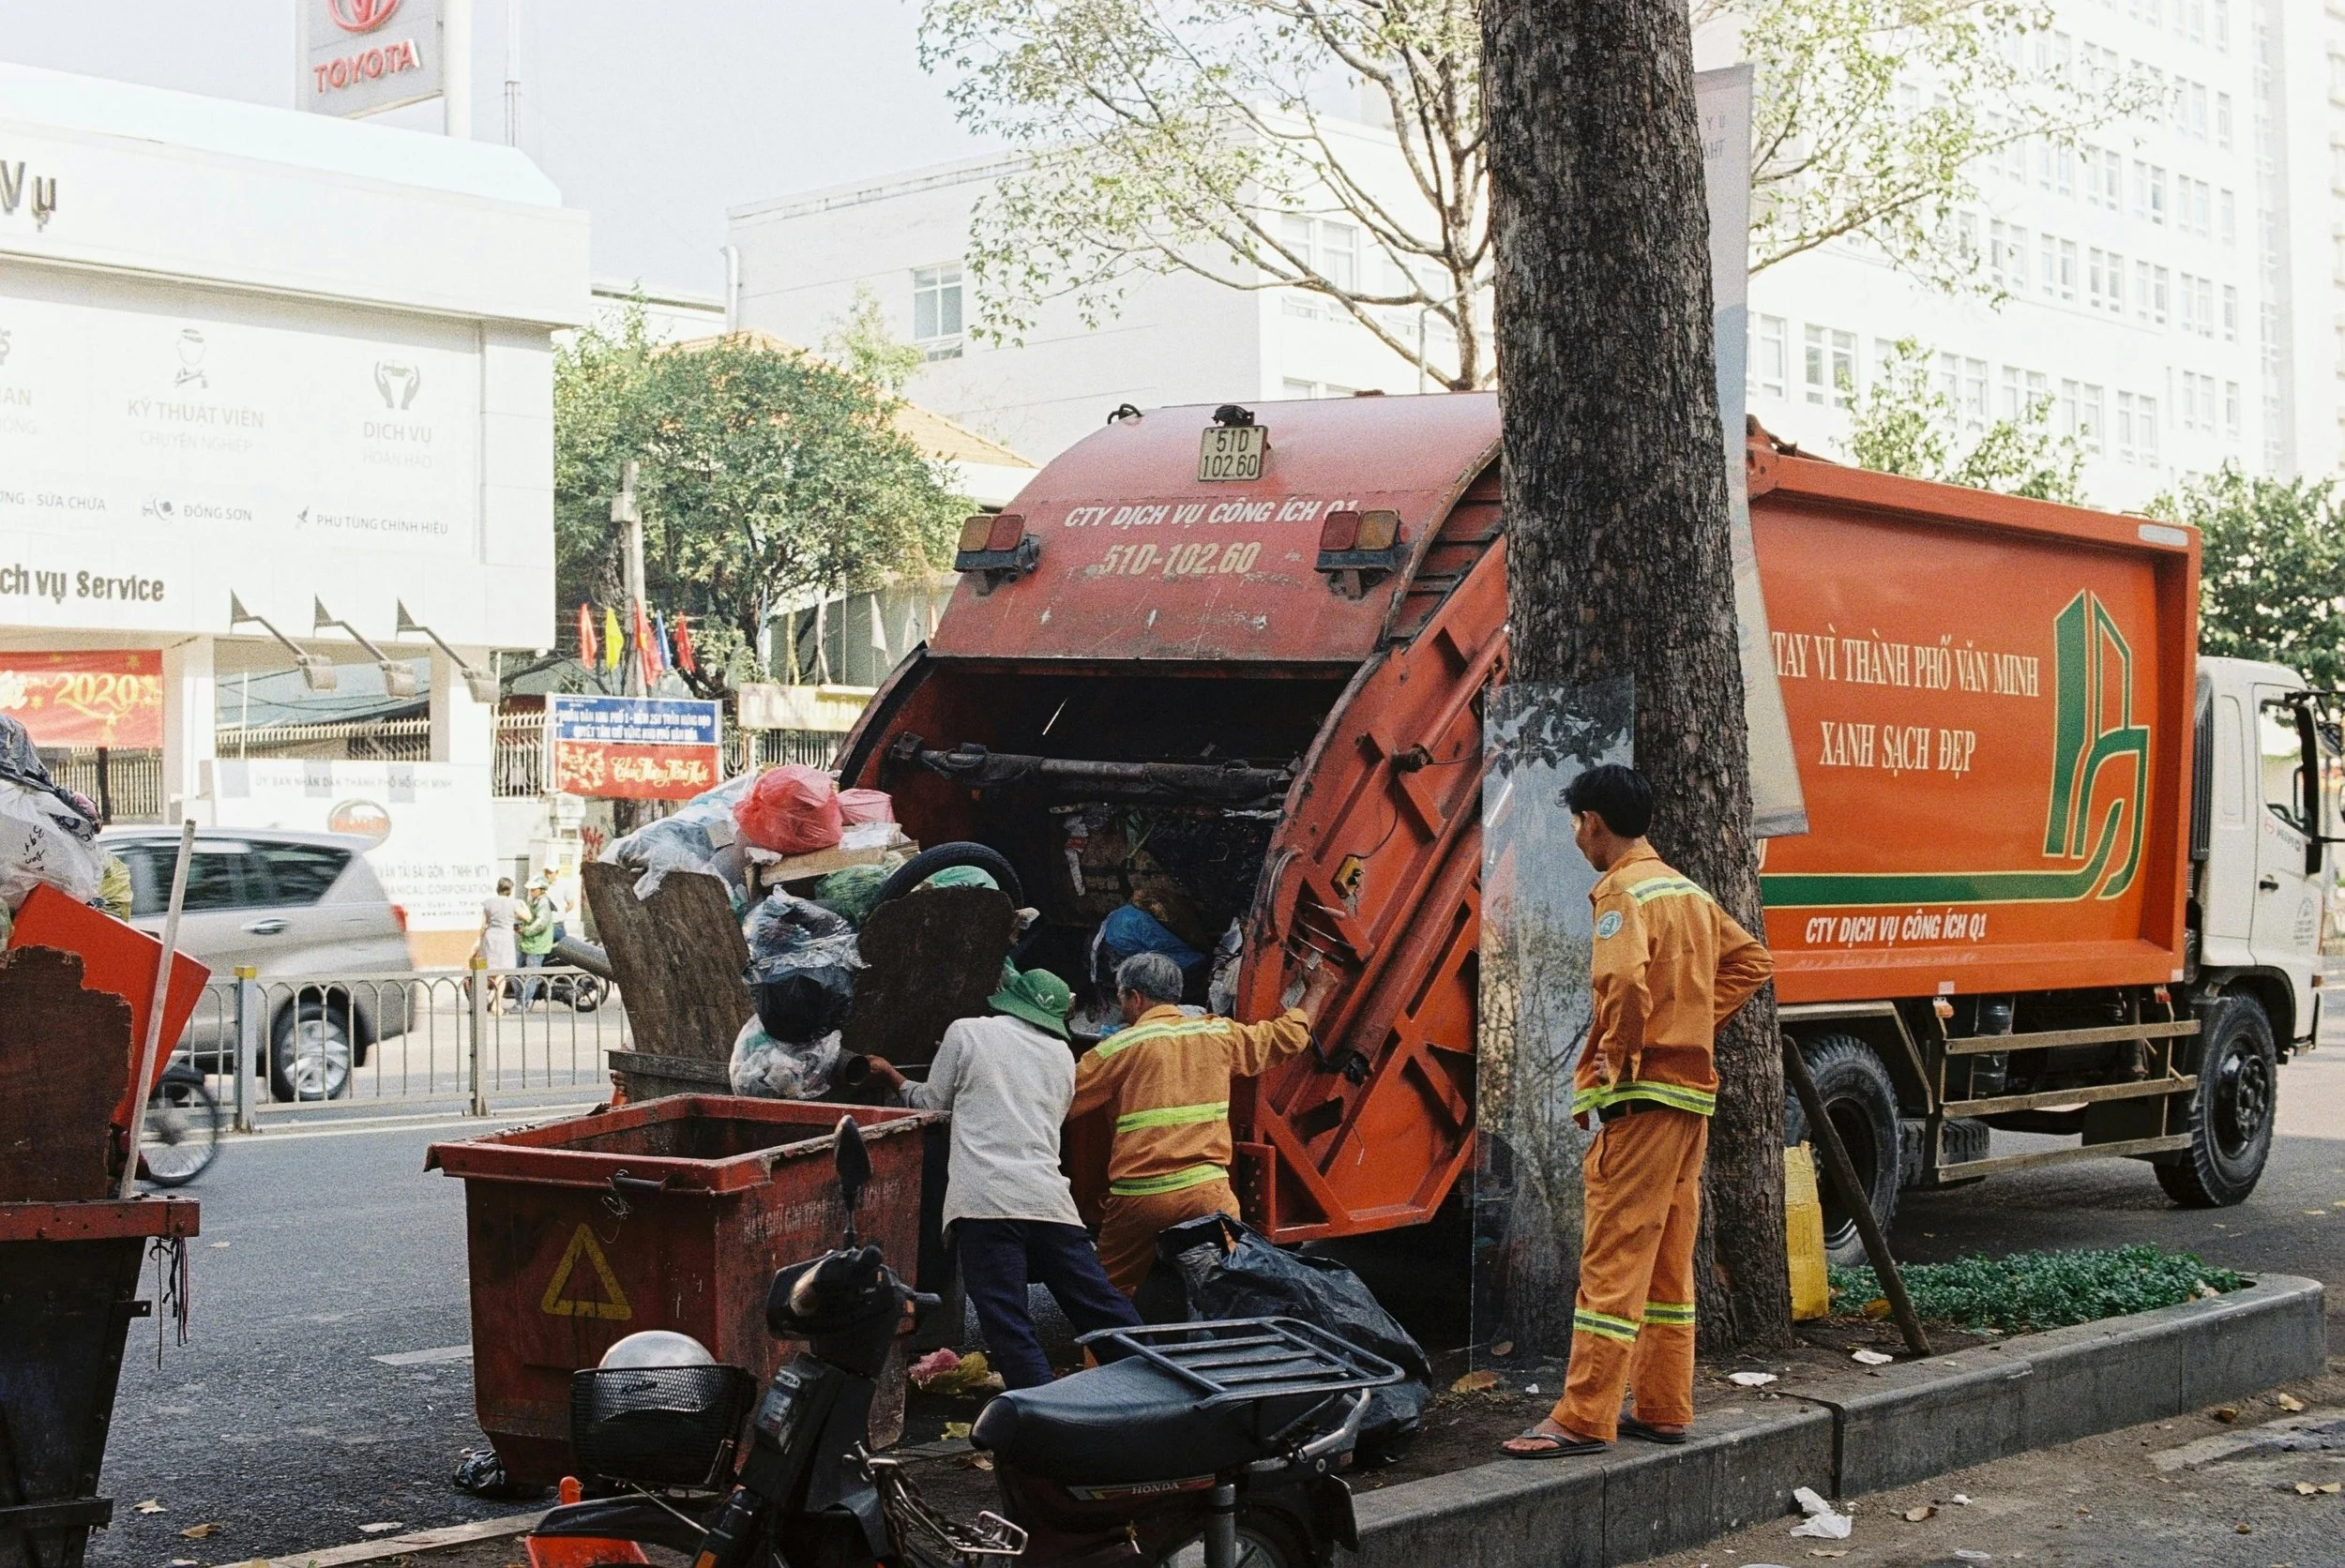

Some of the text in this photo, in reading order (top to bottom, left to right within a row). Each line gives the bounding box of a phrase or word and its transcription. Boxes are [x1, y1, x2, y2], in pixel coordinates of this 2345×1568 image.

[314, 39, 419, 93] TOYOTA
[0, 159, 56, 233] Vụ
[0, 387, 31, 406] AN
[363, 421, 432, 448] DỊCH VỤ
[1217, 430, 1248, 452] 51D
[1203, 455, 1258, 477] 102.60
[1066, 505, 1113, 527] CTY
[1110, 505, 1172, 530] DỊCH
[1172, 503, 1207, 529] VỤ
[1207, 497, 1275, 524] CÔNG
[1275, 496, 1324, 522] ÍCH
[1099, 541, 1263, 575] 51D-102.60
[0, 563, 165, 605] ch vụ Service
[1772, 623, 2039, 698] TAY VÌ THÀNH PHỐ VĂN MINH
[53, 672, 140, 708] 2020
[1819, 721, 1976, 780] XANH SẠCH ĐẸP
[1806, 907, 1988, 948] CTY DỊCH VỤ CÔNG ÍCH Q1
[1131, 1482, 1180, 1494] HONDA
